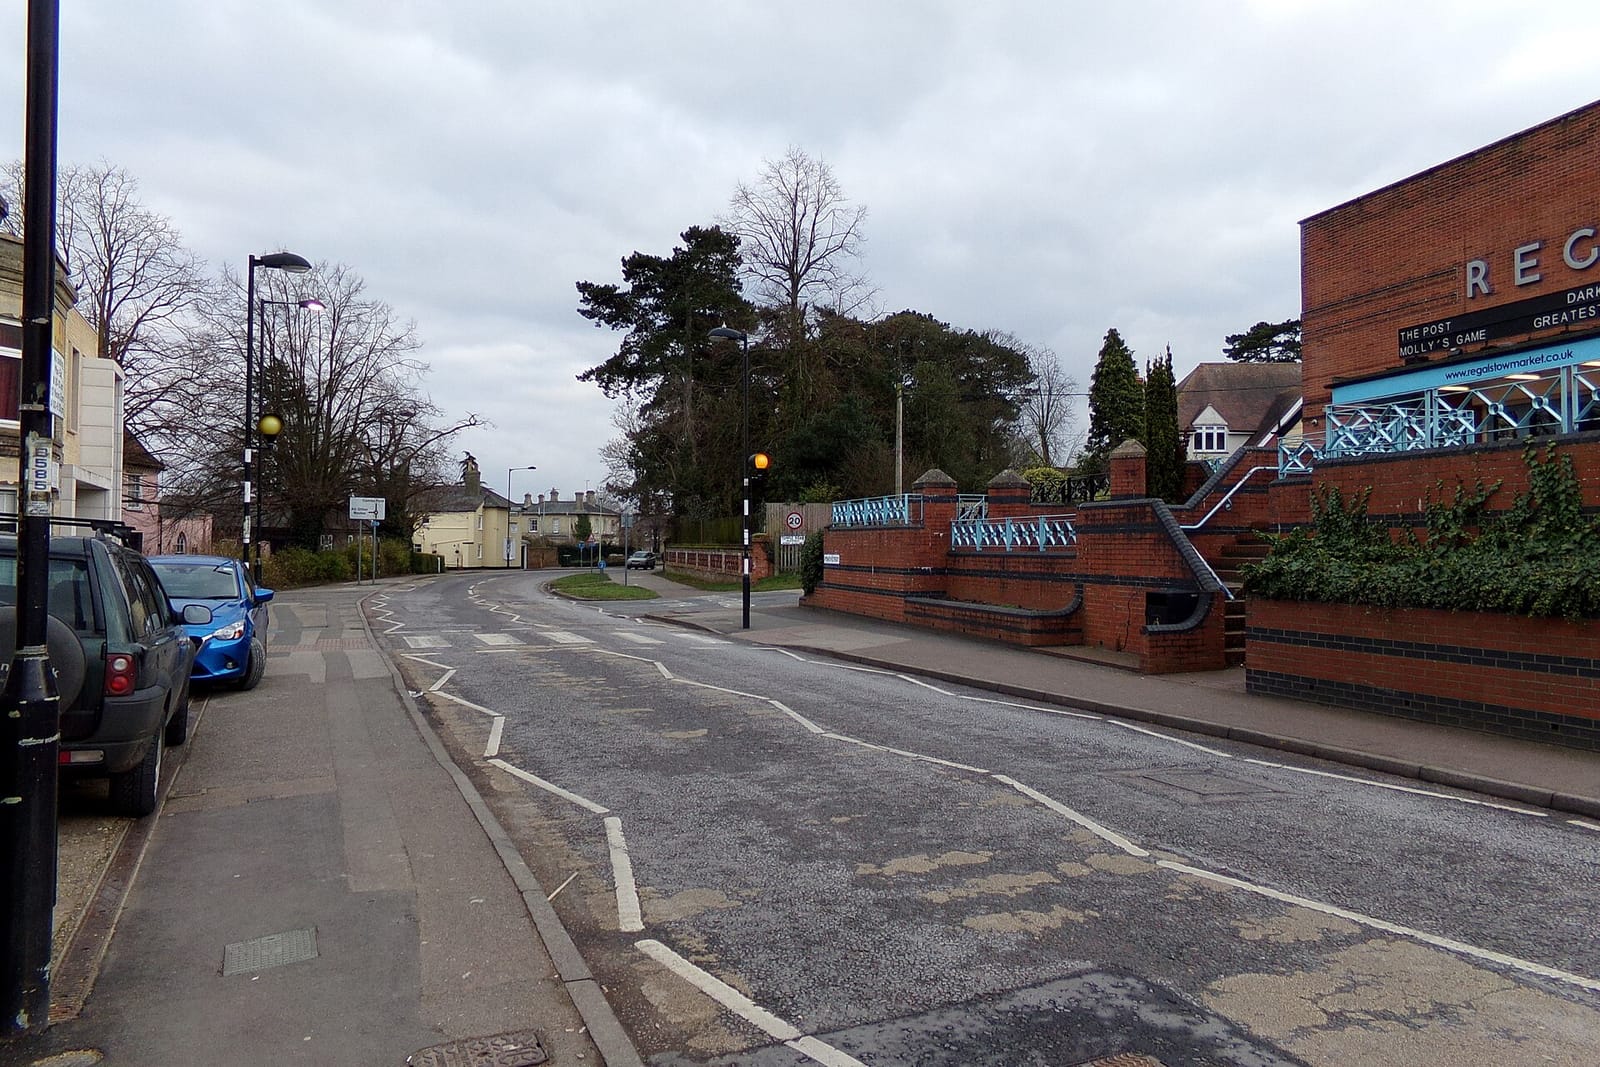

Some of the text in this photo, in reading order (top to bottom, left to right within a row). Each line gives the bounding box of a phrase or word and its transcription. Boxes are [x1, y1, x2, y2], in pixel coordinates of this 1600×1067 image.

[1399, 329, 1486, 357] MOLLY'S GAME
[1400, 321, 1452, 341] THE POST
[1444, 349, 1574, 380] www.regalstowmarket.co.uk
[789, 517, 800, 525] 20
